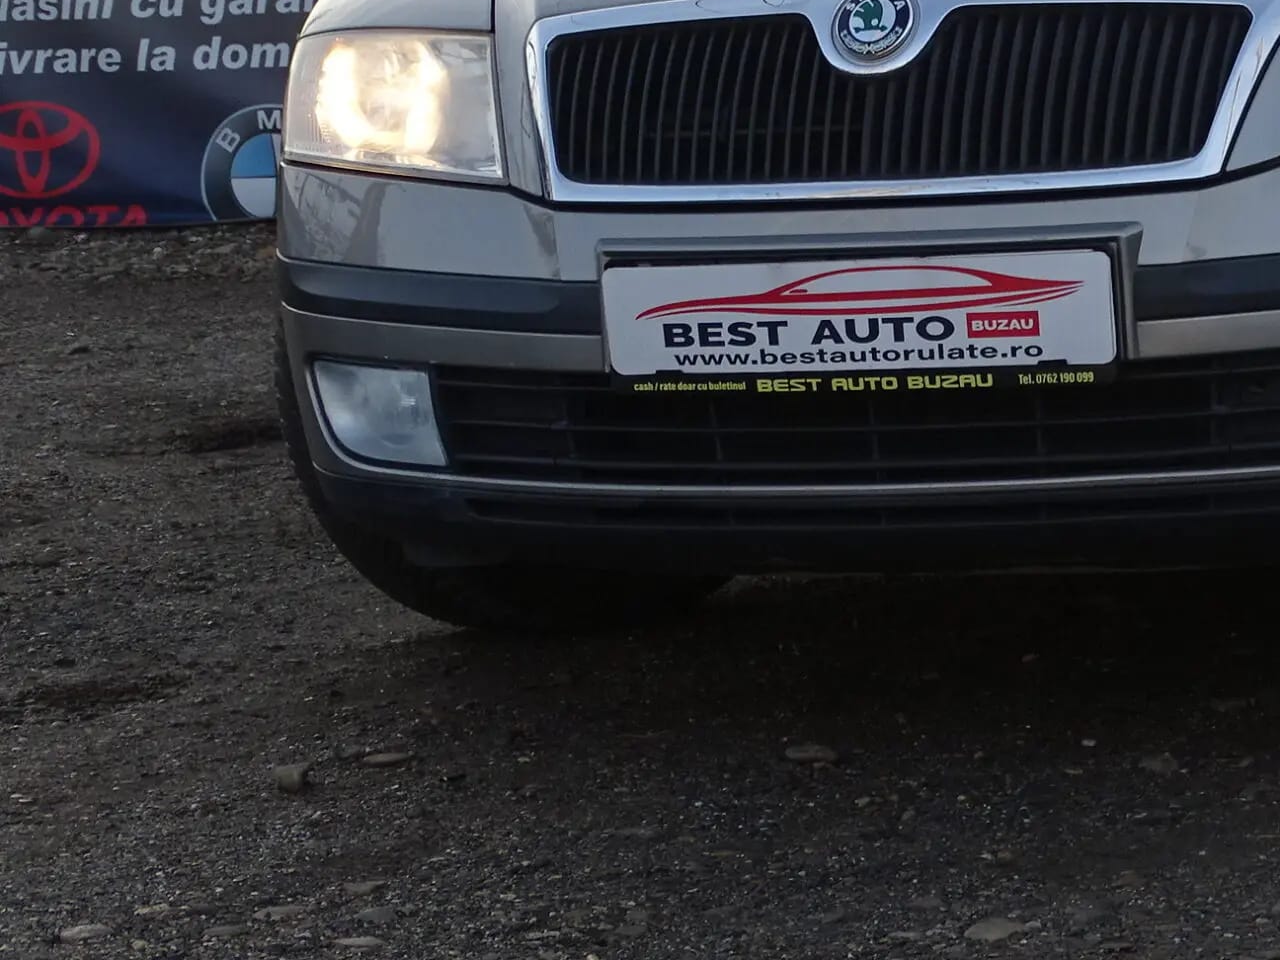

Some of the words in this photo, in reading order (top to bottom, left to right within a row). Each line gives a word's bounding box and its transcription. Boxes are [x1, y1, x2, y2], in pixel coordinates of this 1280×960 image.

[136, 38, 176, 73] la
[193, 36, 290, 71] dom
[662, 320, 788, 348] BEST
[811, 315, 955, 345] AUTO
[971, 317, 1034, 332] BUZAU
[674, 343, 1043, 366] www.bestautorulate.ro
[633, 381, 653, 391] cash
[659, 382, 676, 391] rate
[677, 381, 696, 391] doar
[697, 382, 708, 391] cu
[756, 378, 822, 392] BEST
[831, 376, 898, 391] AUTO
[907, 373, 994, 389] BUZAU
[1018, 373, 1035, 385] Tel.
[1036, 372, 1058, 384] 0762
[1059, 372, 1075, 383] 190
[1076, 371, 1094, 382] 099
